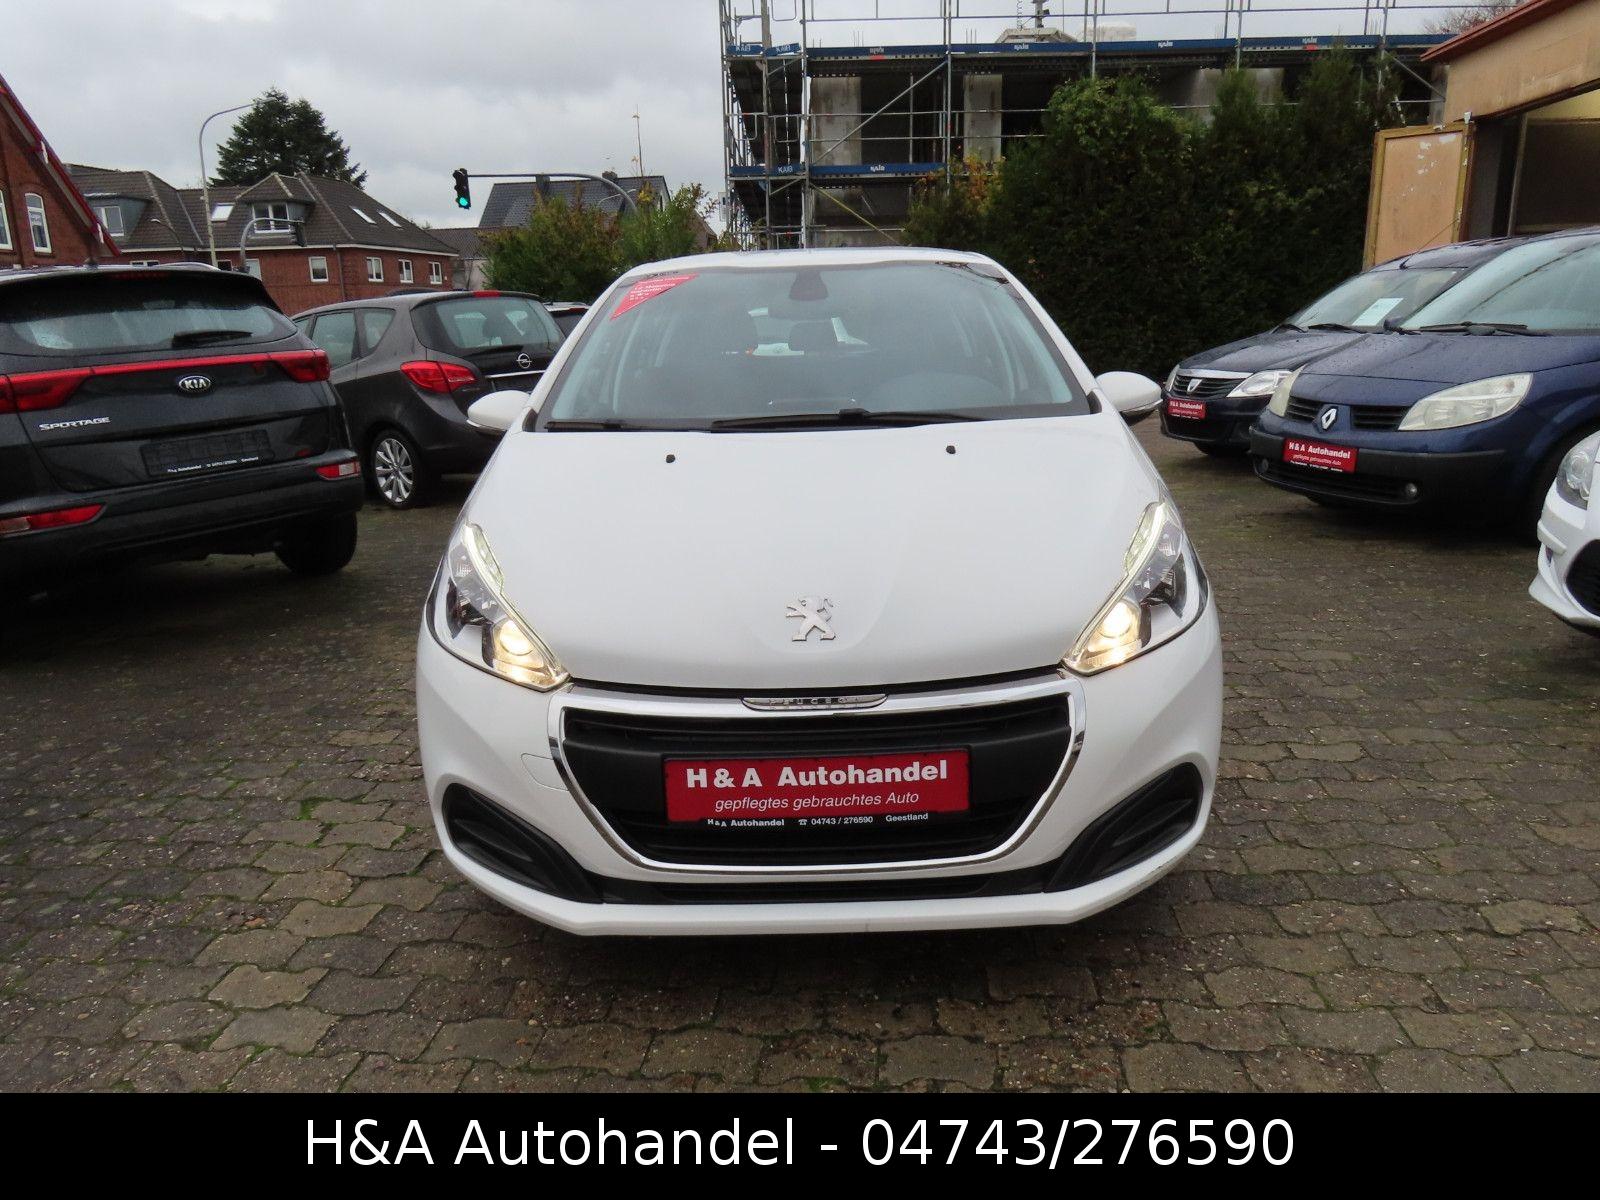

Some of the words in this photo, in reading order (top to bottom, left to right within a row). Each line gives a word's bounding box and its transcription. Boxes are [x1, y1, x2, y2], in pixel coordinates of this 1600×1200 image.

[39, 416, 111, 431] SPORTAGE
[1308, 445, 1351, 459] Autohandel
[778, 760, 948, 787] Autohandel
[715, 795, 789, 813] gepflegtes
[793, 792, 882, 811] gebrauchtes
[885, 791, 919, 805] Auto
[731, 818, 785, 827] Autohandel
[886, 812, 929, 823] Geestland
